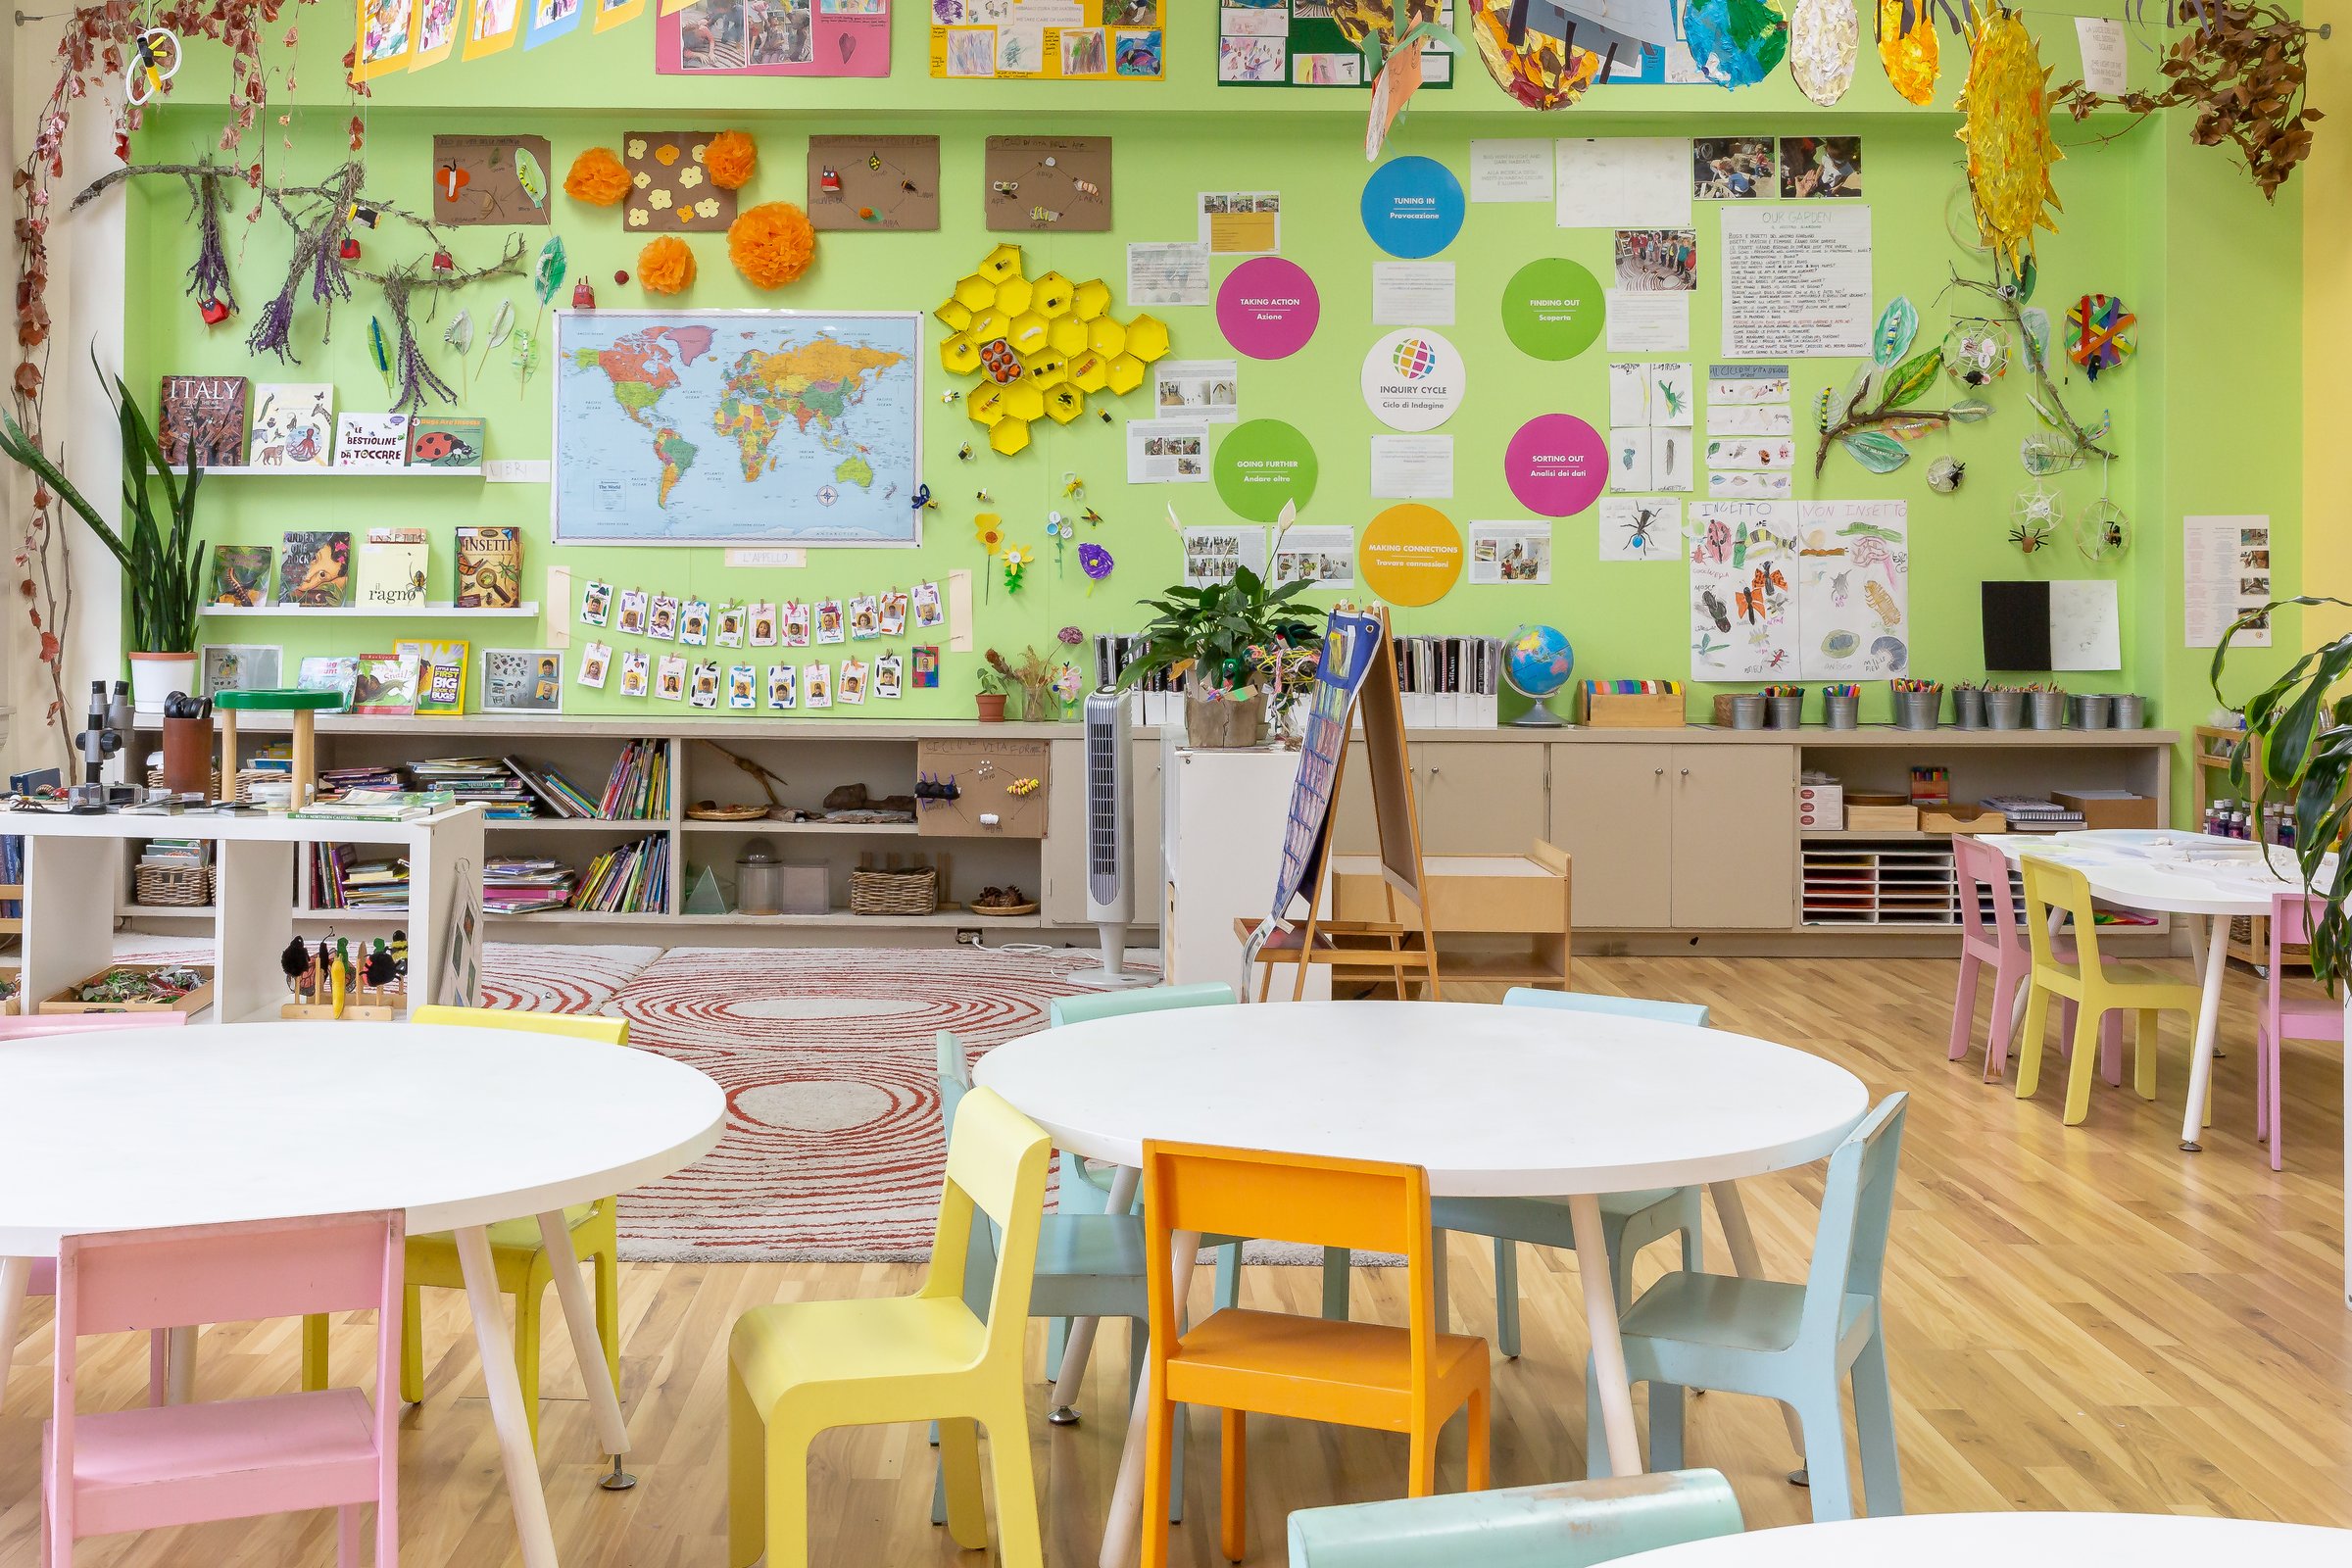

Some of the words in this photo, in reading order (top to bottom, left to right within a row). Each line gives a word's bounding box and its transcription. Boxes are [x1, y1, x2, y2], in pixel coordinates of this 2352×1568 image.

[991, 198, 1005, 207] APE
[1762, 211, 1785, 223] OUR
[1788, 211, 1833, 223] GARDEN
[1539, 314, 1572, 322] Scoperta
[171, 380, 241, 400] ITALY
[1380, 385, 1419, 394] INQUIRY
[1420, 385, 1446, 394] CYCLE
[1411, 401, 1445, 411] Indagine
[347, 436, 398, 446] BESTIOLINE
[340, 450, 352, 459] DA
[354, 449, 402, 460] TOCCARE
[1244, 474, 1272, 483] Andare
[1273, 474, 1291, 483] oltre
[1802, 505, 1835, 518] NON
[286, 532, 315, 544] UNDER
[290, 543, 309, 555] ONE
[466, 539, 512, 552] INSETTI
[1402, 545, 1458, 554] CONNECTIONS
[287, 554, 310, 564] ROCK
[743, 553, 788, 564] L'APPELLO
[368, 589, 416, 605] ragno
[383, 670, 414, 680] Snail?
[433, 677, 458, 689] BIG
[431, 692, 456, 701] BUGS
[983, 742, 1007, 753] VITA
